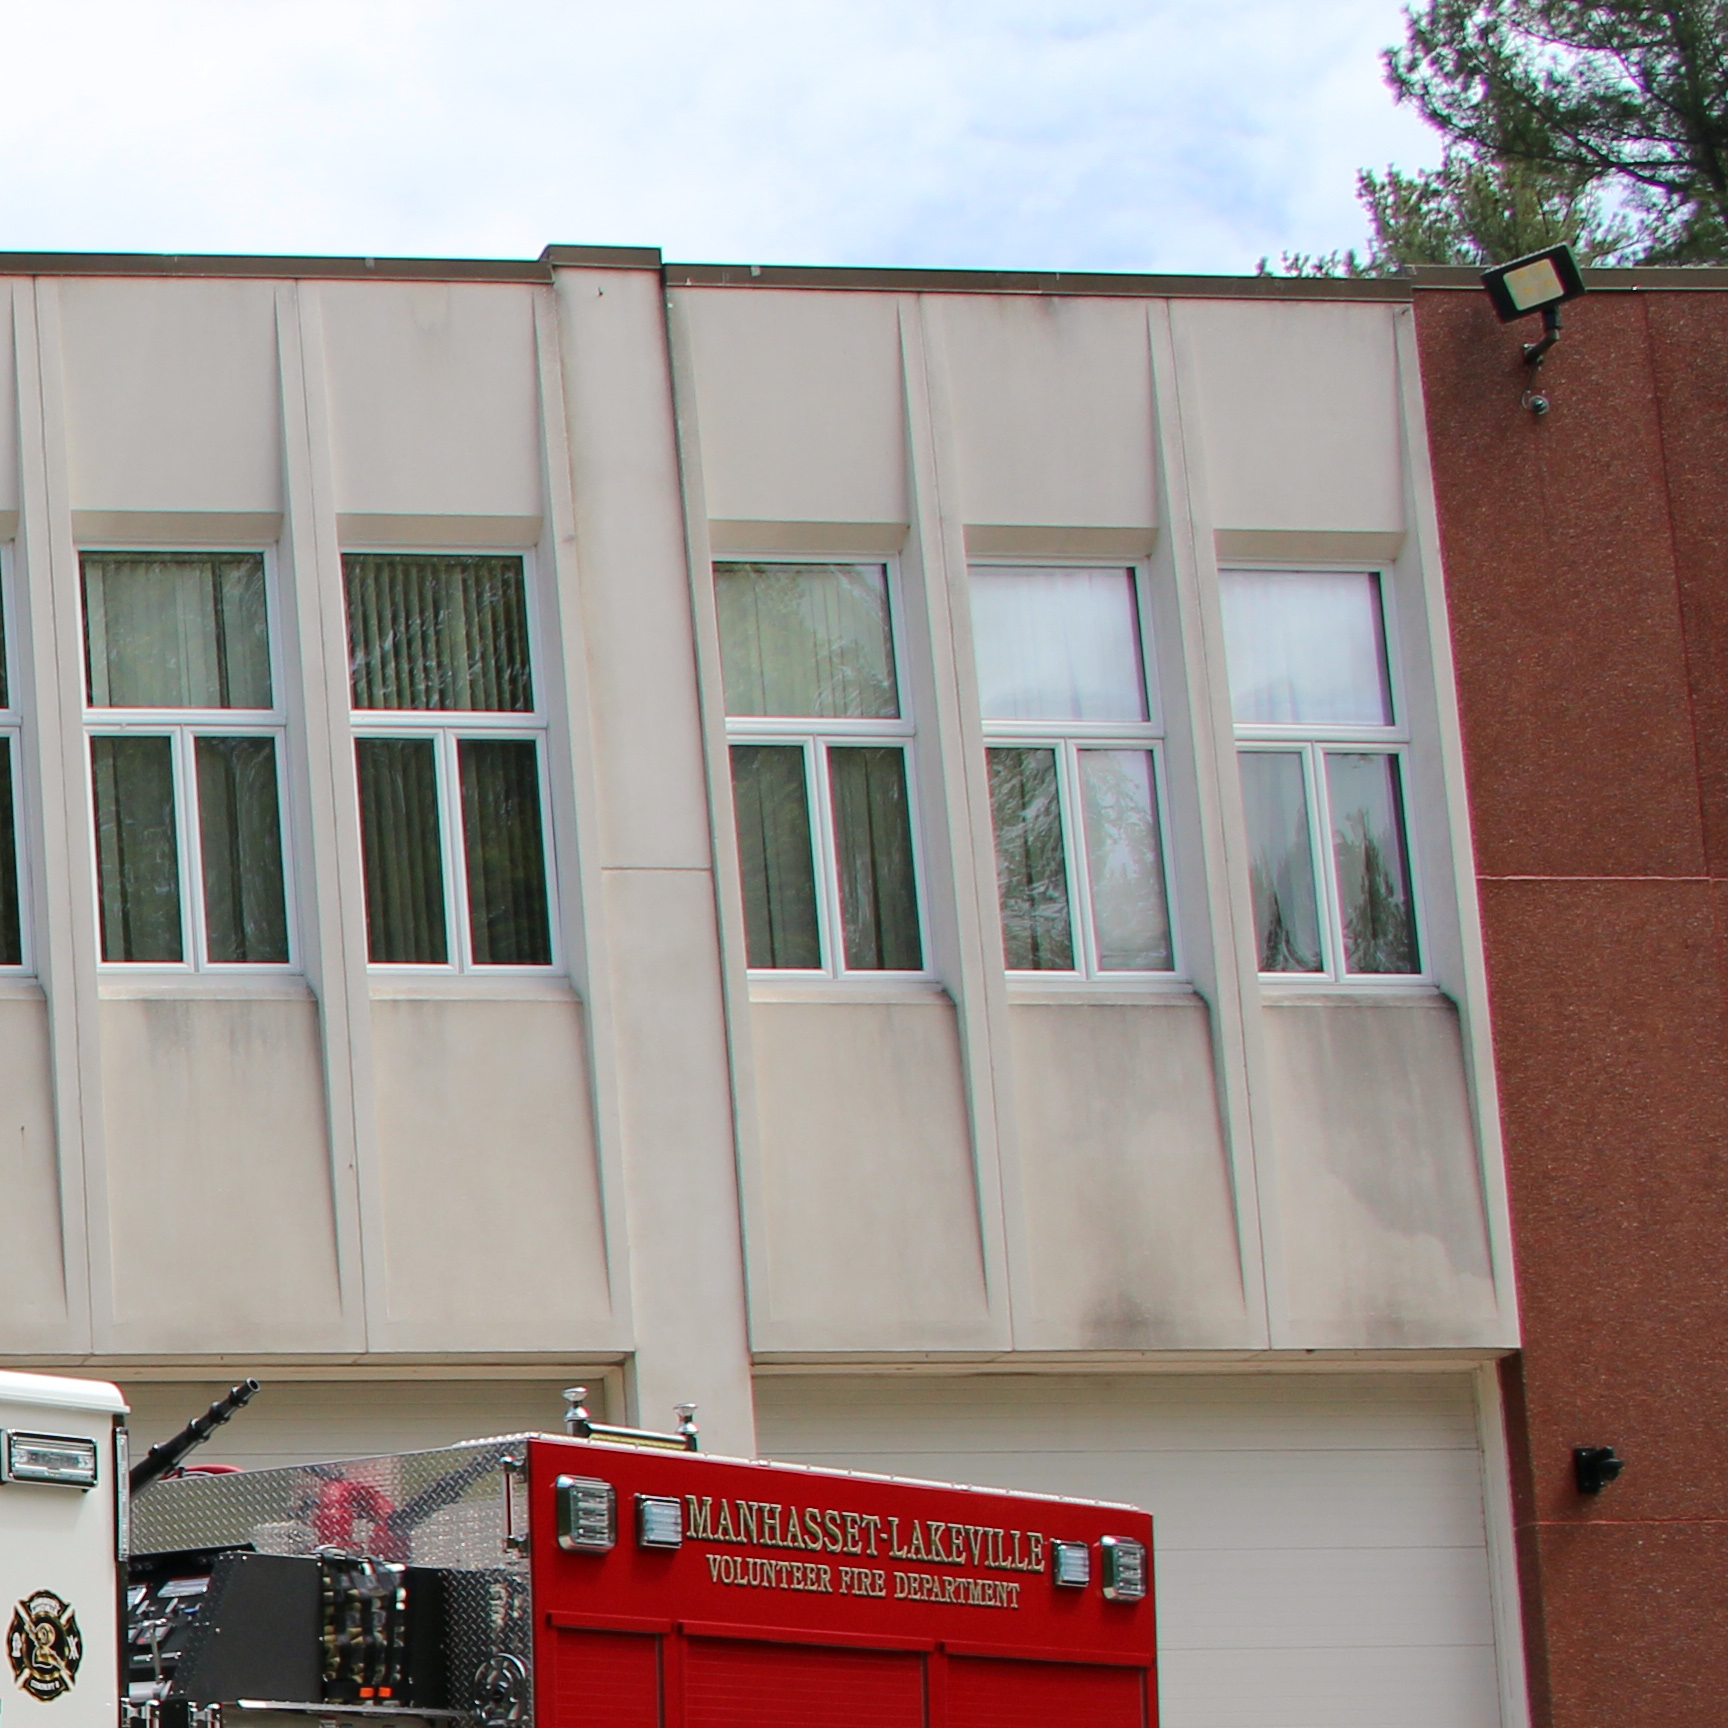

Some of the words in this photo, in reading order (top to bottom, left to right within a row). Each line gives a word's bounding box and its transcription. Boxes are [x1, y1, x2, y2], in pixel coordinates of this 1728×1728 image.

[684, 1494, 1045, 1573] MANHASSET-LAKEVILLE
[705, 1554, 834, 1593] VOLUNTEER
[839, 1566, 886, 1598] FIRE
[893, 1571, 1021, 1609] DEPARTMENT
